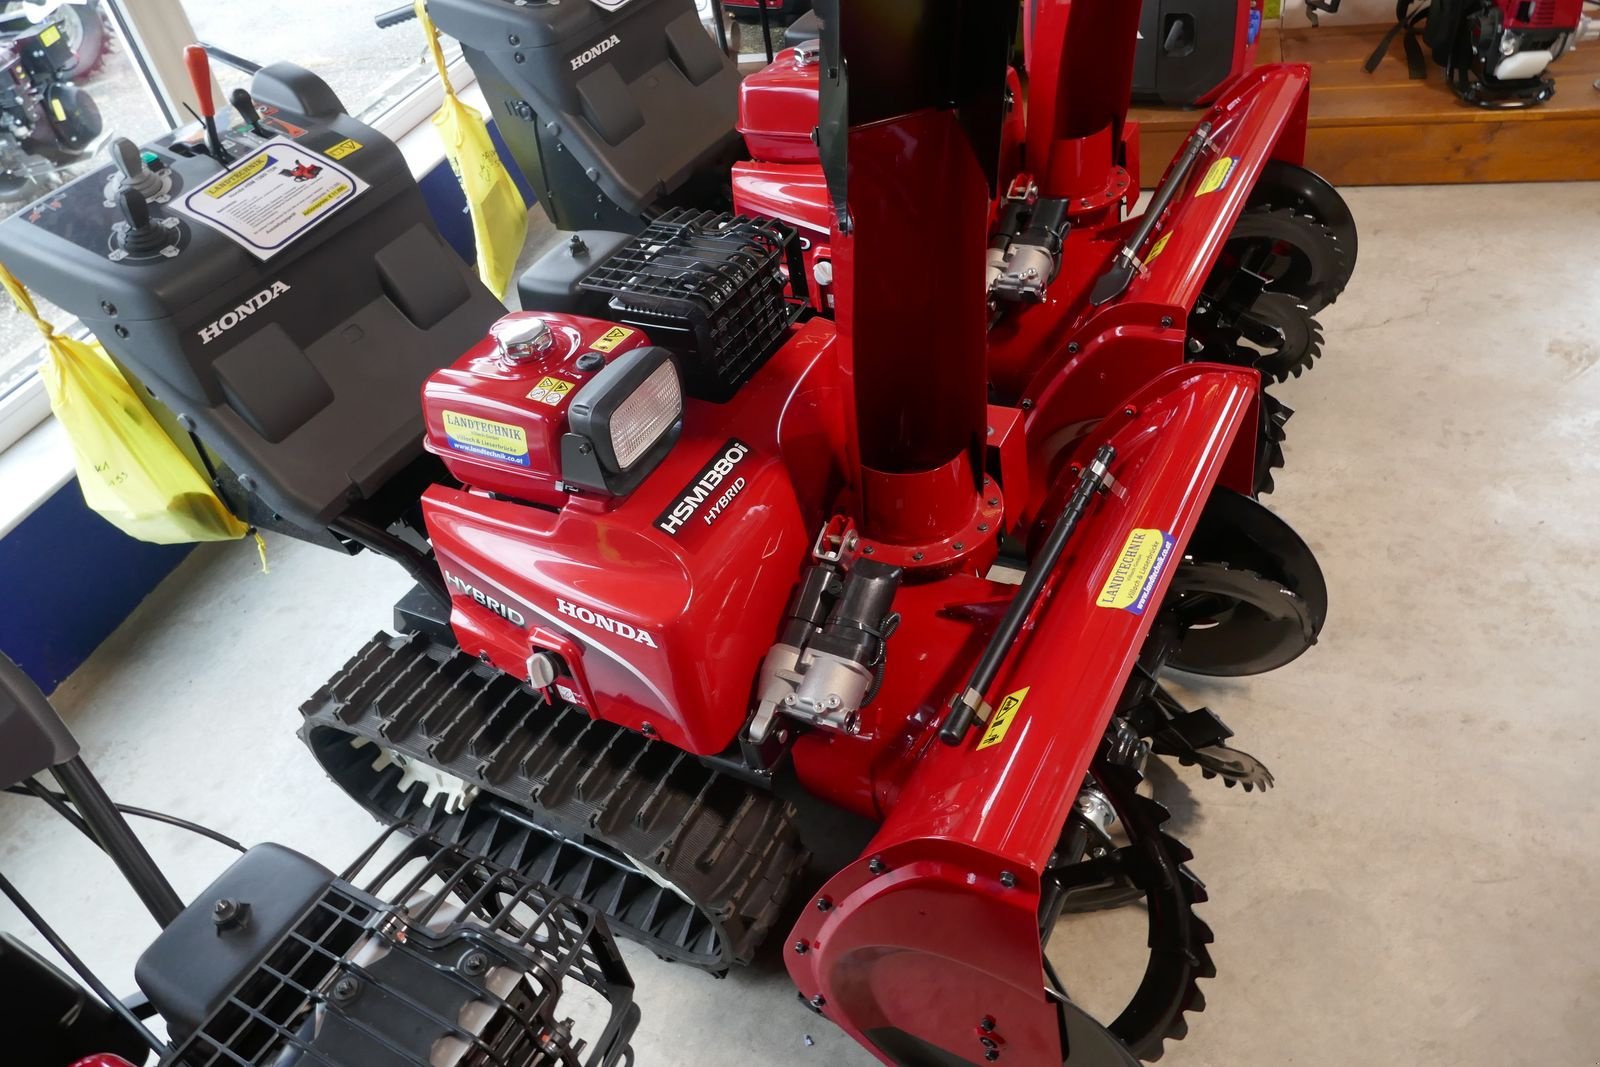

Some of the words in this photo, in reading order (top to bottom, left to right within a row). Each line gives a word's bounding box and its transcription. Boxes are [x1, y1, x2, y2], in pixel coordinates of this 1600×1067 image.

[570, 34, 621, 71] HONDA
[208, 158, 265, 195] LANDTECHNIK
[198, 280, 291, 345] HONDA
[447, 414, 522, 440] LANDTECHNIK
[660, 442, 748, 534] HSM1380i
[704, 477, 745, 525] HYBRID
[1102, 533, 1146, 603] LANDTECHNIK
[1128, 579, 1141, 599] Villach
[1137, 541, 1172, 609] www.landtechnik.co.at
[444, 570, 525, 627] HYBRID
[556, 598, 658, 649] HONDA
